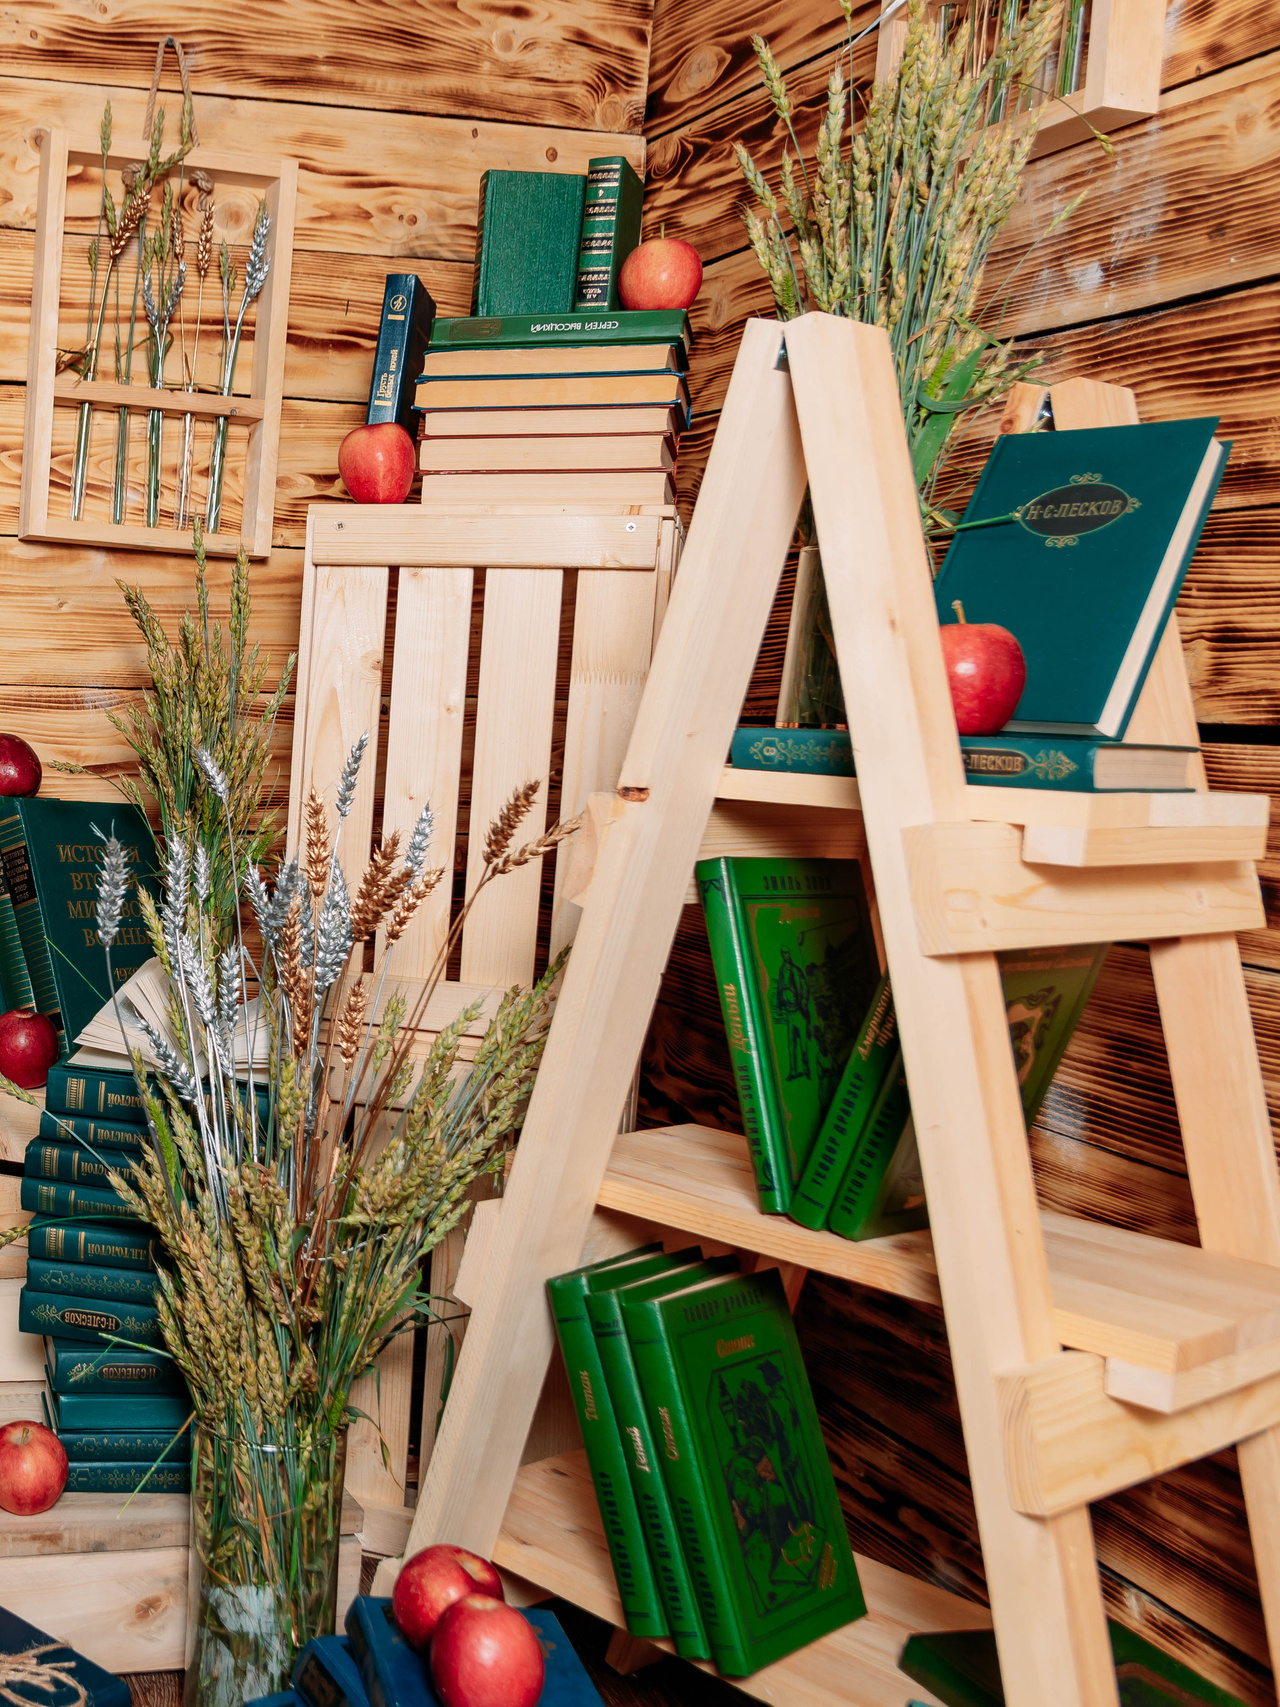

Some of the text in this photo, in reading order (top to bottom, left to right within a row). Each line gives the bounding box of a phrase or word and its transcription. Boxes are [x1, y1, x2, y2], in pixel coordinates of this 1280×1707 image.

[530, 321, 619, 333] СЕРГЕЙ ВЫСОЦКИЙ
[377, 372, 388, 398] Грусть
[56, 844, 141, 863] ИСТОИЯ
